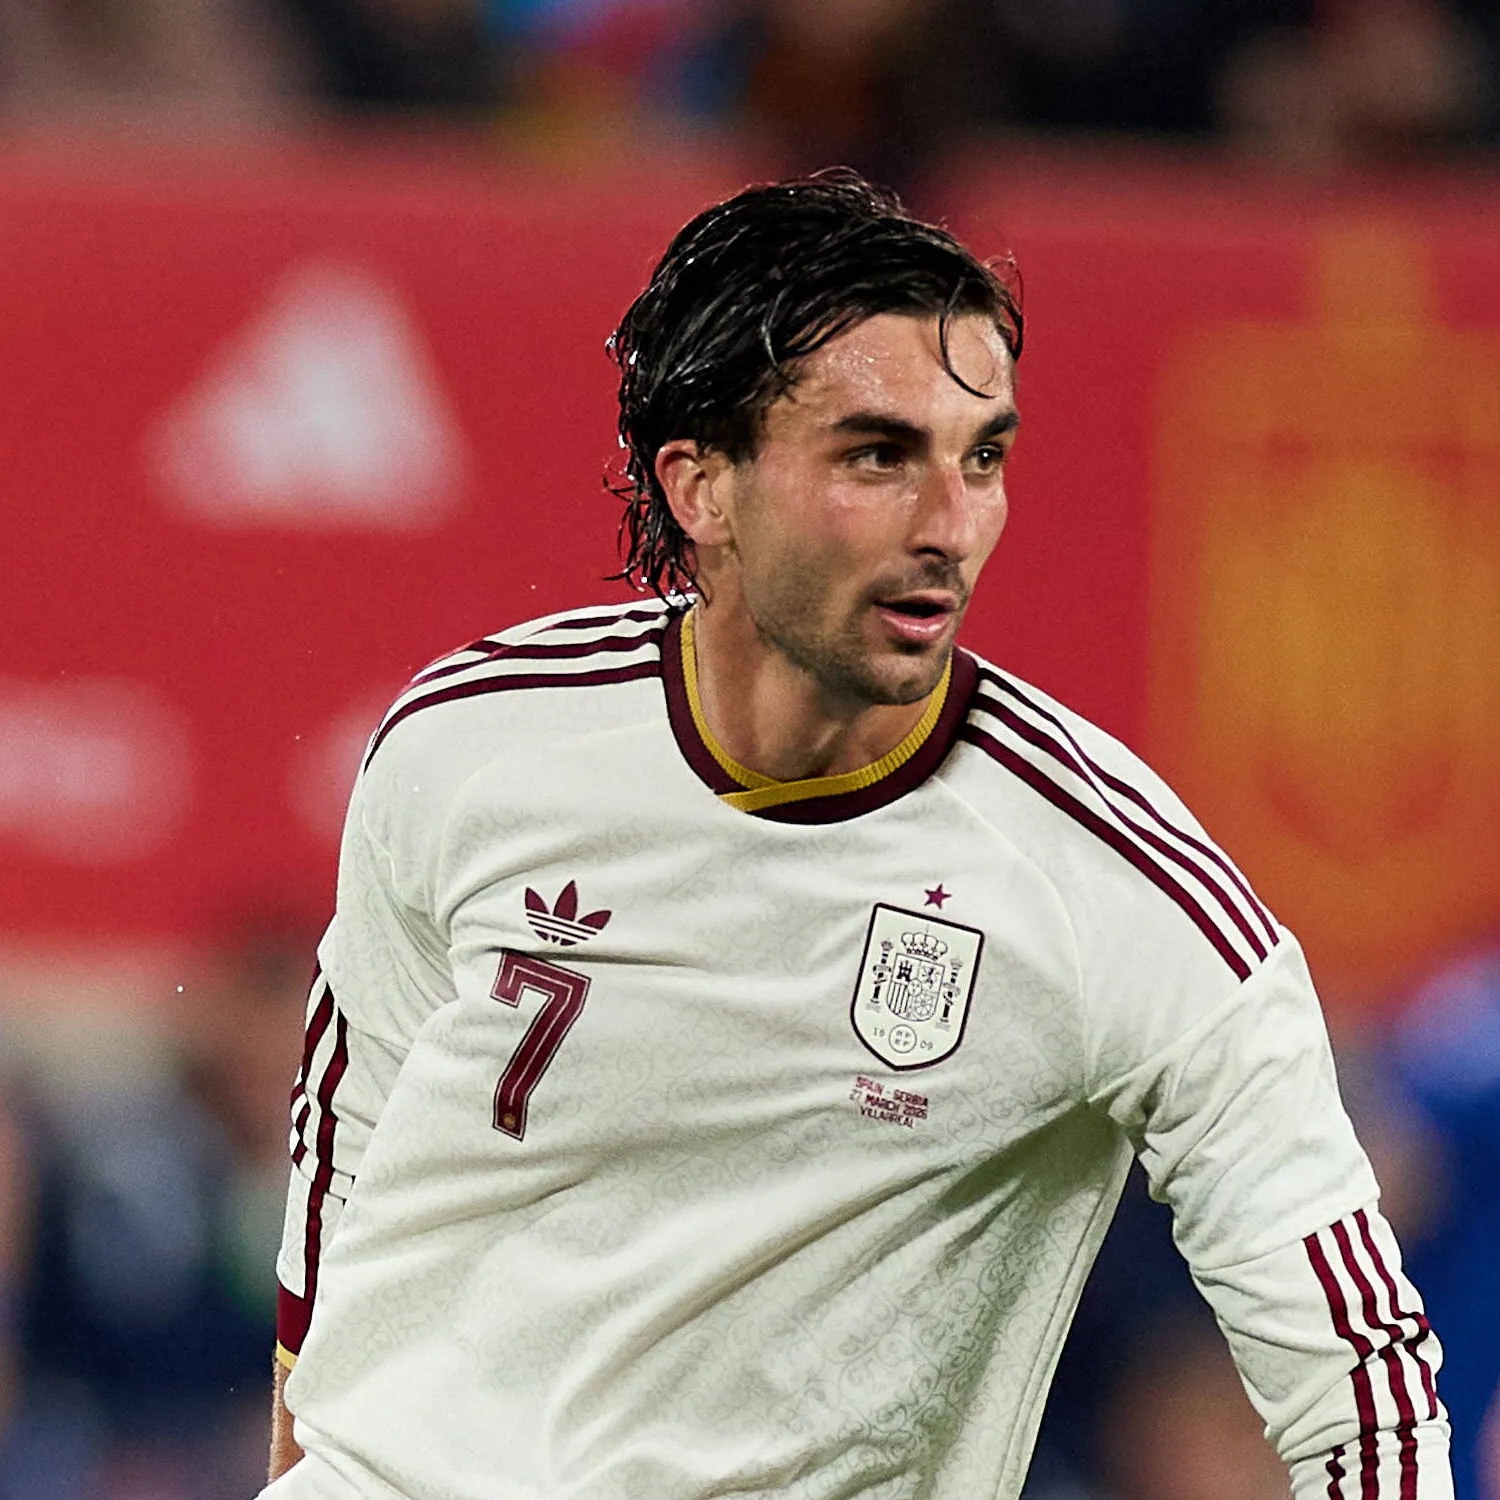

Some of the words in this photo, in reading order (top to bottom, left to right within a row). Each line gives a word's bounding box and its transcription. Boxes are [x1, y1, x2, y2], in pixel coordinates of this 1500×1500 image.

[490, 947, 592, 1142] 7
[856, 1076, 884, 1095] SPAIN
[893, 1089, 929, 1106] SERBIA
[865, 1094, 900, 1113] MARCH
[860, 1105, 914, 1129] VILLARREAL
